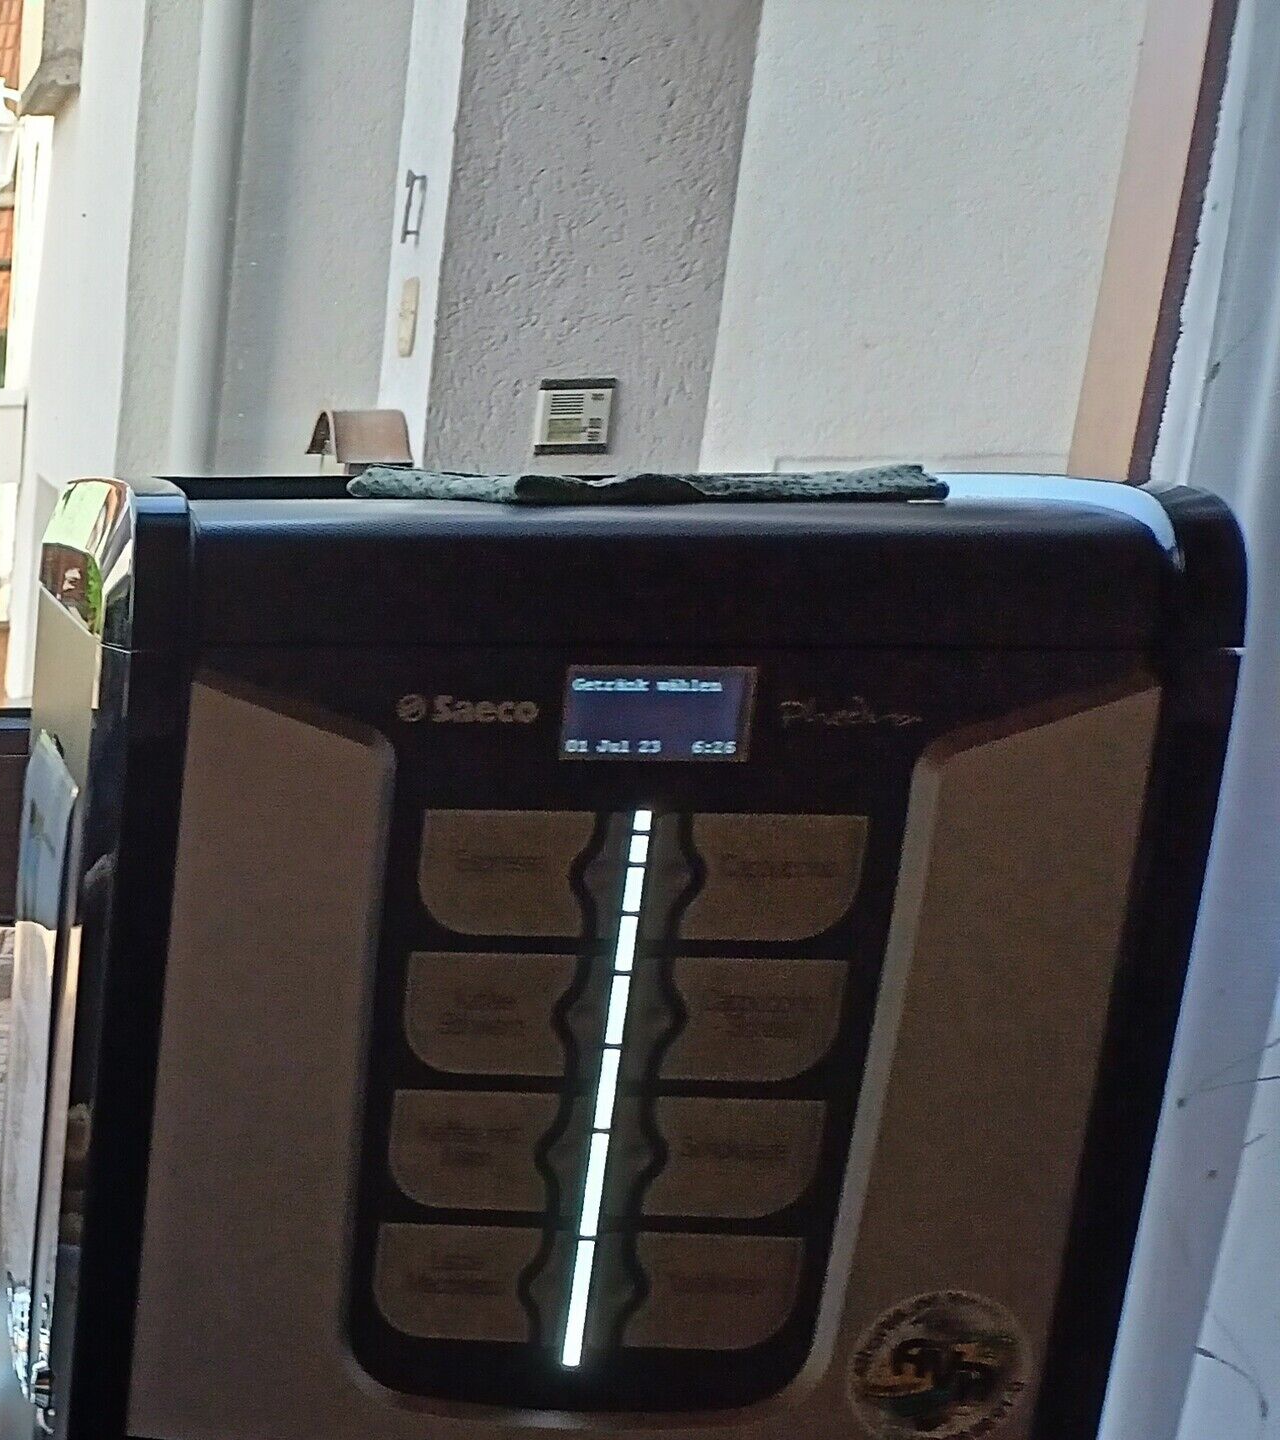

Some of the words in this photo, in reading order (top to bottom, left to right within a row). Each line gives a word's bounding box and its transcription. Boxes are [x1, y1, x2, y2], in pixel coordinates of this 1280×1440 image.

[430, 695, 539, 724] Saeco
[564, 739, 589, 754] 01
[595, 739, 632, 754] Jul
[638, 740, 663, 754] 23
